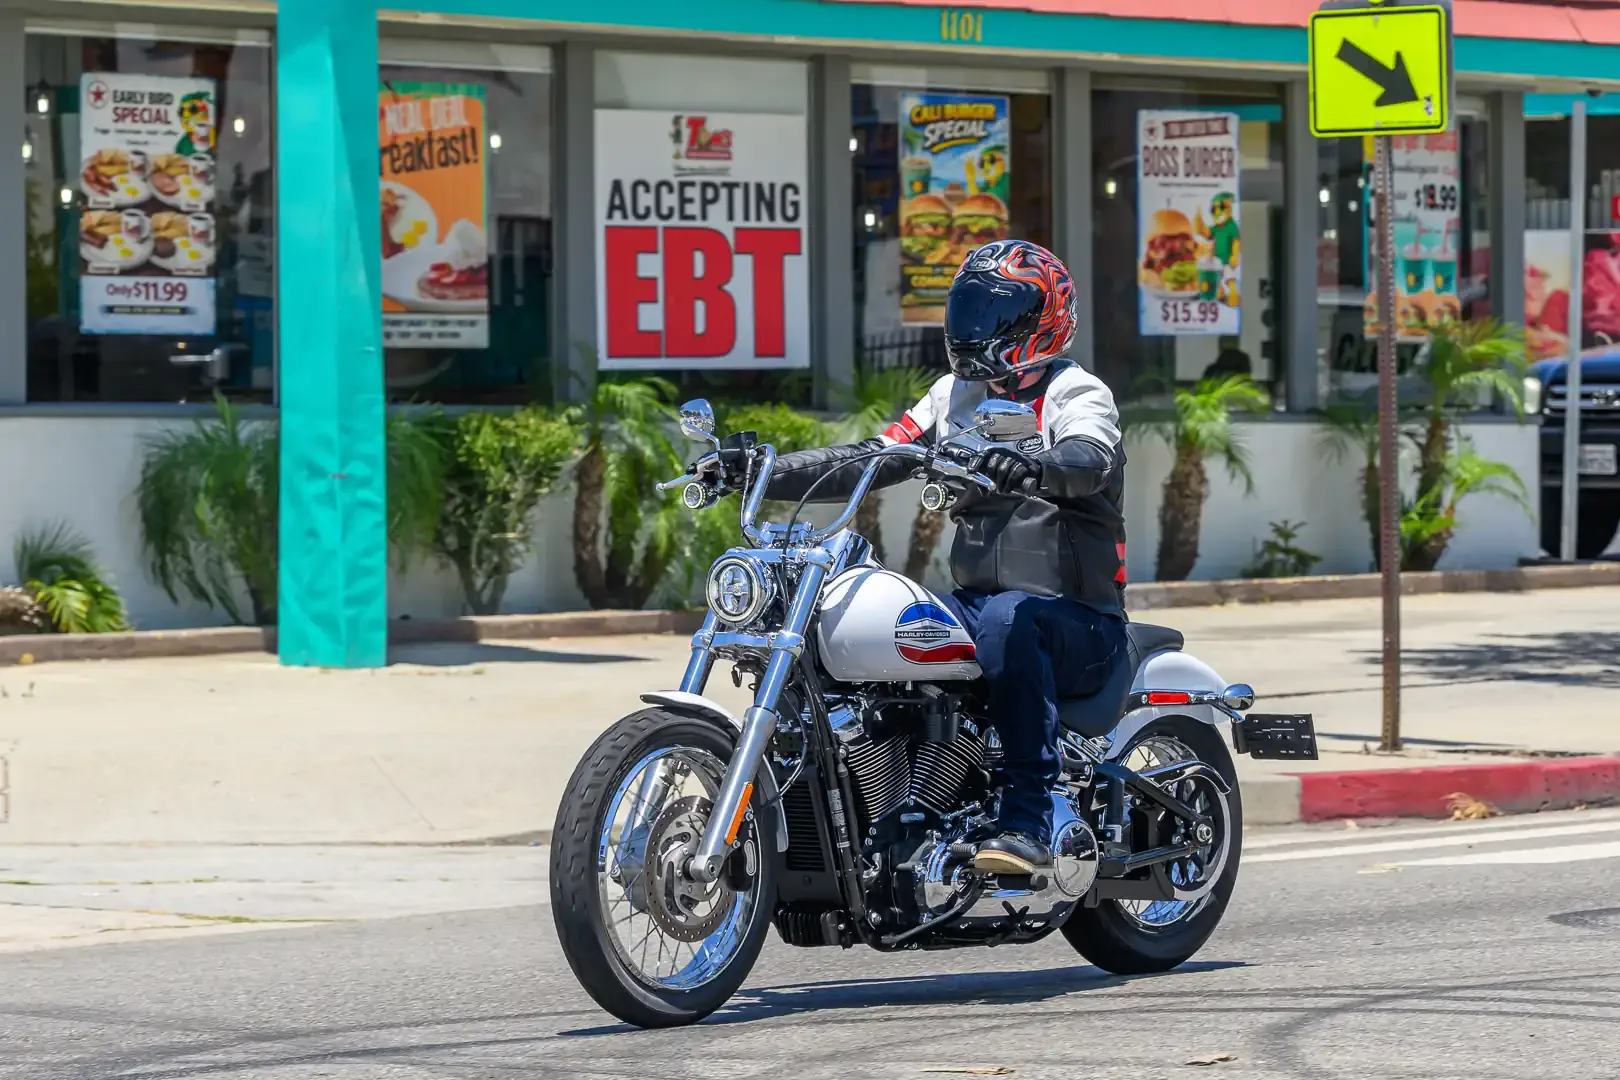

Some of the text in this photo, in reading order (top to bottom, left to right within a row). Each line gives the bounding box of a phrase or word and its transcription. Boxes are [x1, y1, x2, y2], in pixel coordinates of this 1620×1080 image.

[941, 10, 982, 42] 1101
[112, 90, 174, 105] EARLY BIRD
[112, 106, 172, 125] SPECIAL
[924, 120, 988, 147] SPECIAL
[379, 127, 478, 177] reakfast!
[1143, 145, 1235, 178] BOSS BURGER
[606, 180, 801, 222] ACCEPTING
[106, 281, 188, 302] Only $11.99
[605, 225, 802, 358] EBT
[1161, 300, 1220, 323] $15.99
